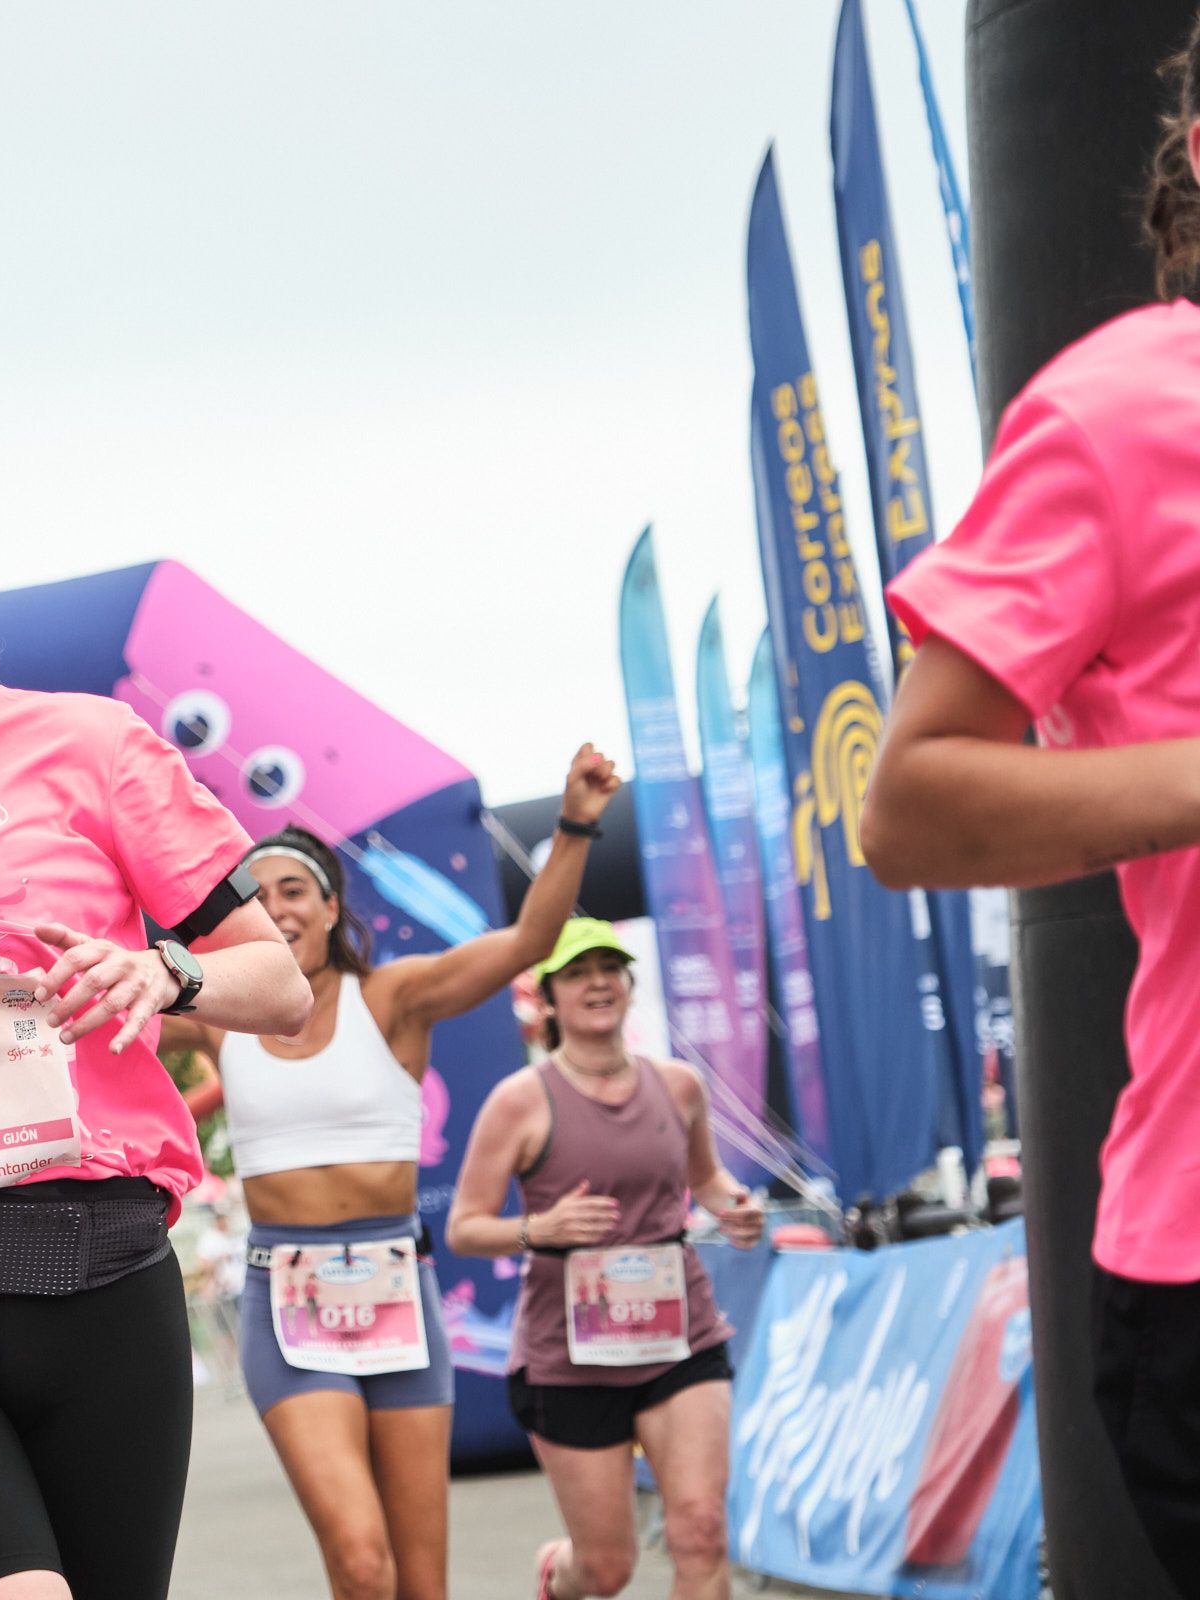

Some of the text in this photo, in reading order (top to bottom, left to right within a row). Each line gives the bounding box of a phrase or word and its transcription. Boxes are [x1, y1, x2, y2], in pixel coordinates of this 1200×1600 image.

[771, 382, 839, 653] Correos
[3, 1126, 39, 1146] GIJÓN
[319, 1303, 377, 1330] 016
